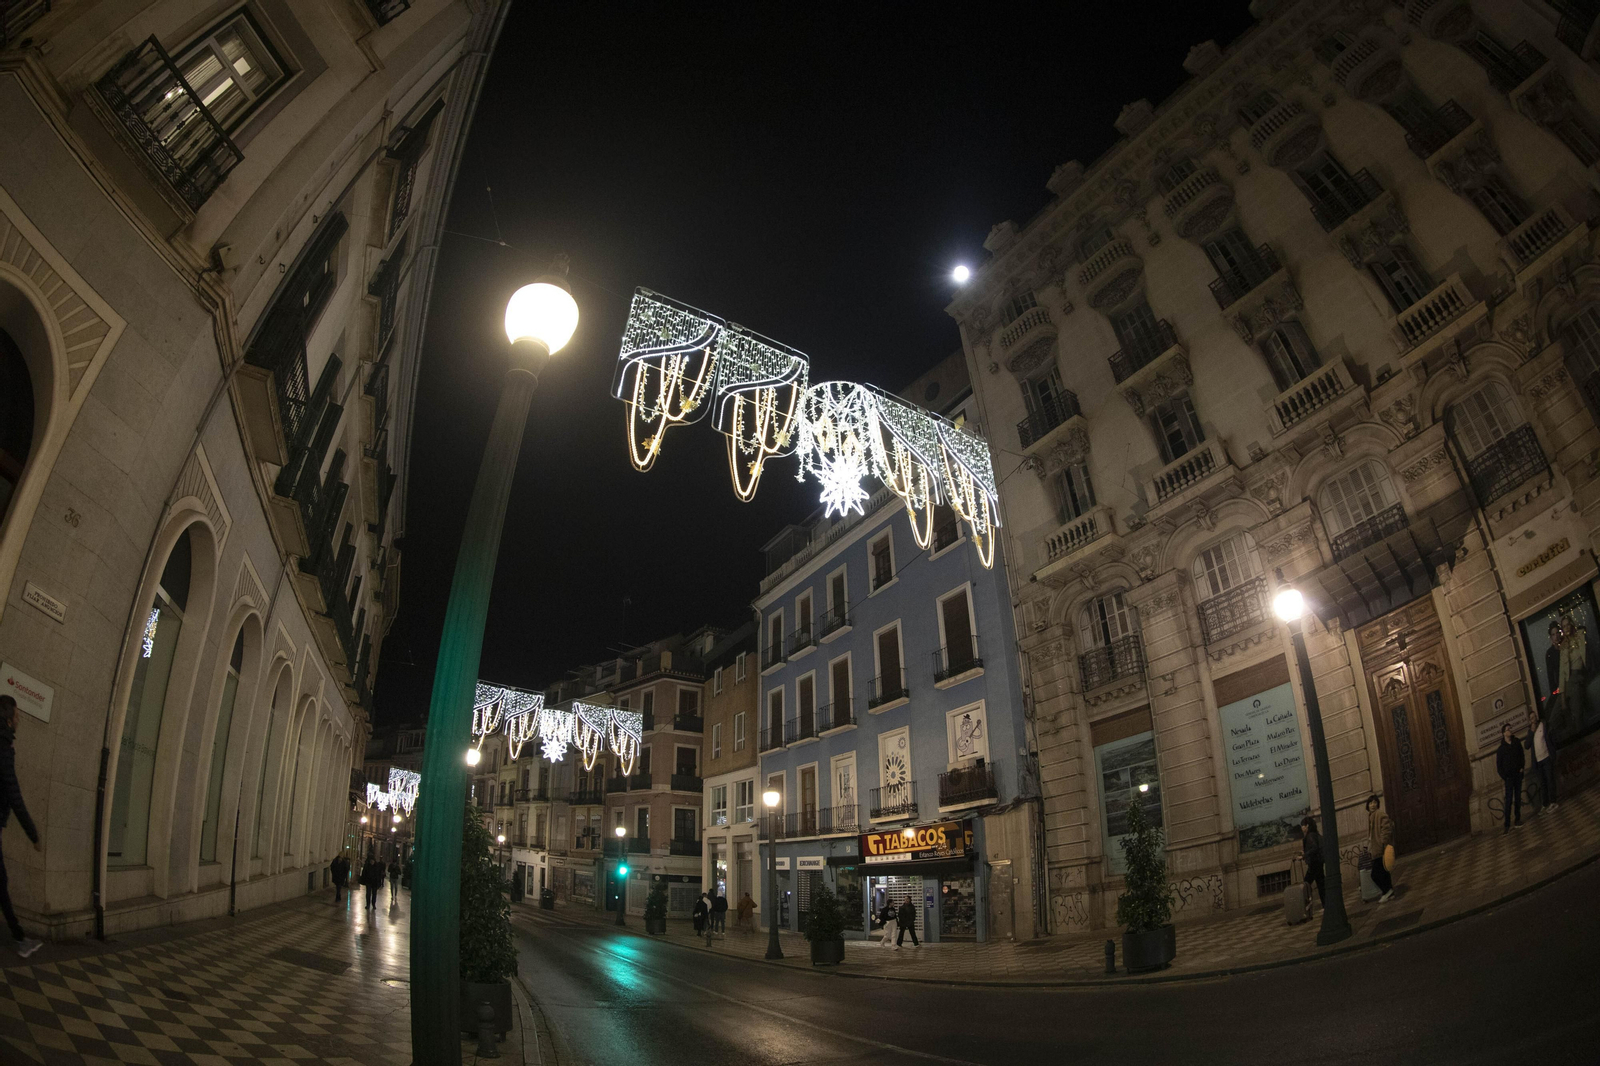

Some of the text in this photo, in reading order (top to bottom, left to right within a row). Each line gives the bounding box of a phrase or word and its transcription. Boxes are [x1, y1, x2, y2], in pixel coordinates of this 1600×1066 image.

[64, 507, 82, 528] 36
[15, 681, 46, 702] Santander
[1265, 717, 1273, 725] La
[1230, 724, 1252, 737] Nevada
[1232, 739, 1260, 751] Gran Plaza
[1269, 746, 1276, 754] El
[1274, 760, 1284, 768] Las
[1278, 787, 1302, 800] Rambla
[884, 827, 946, 849] TABACOS
[799, 859, 821, 867] EXCHANGE
